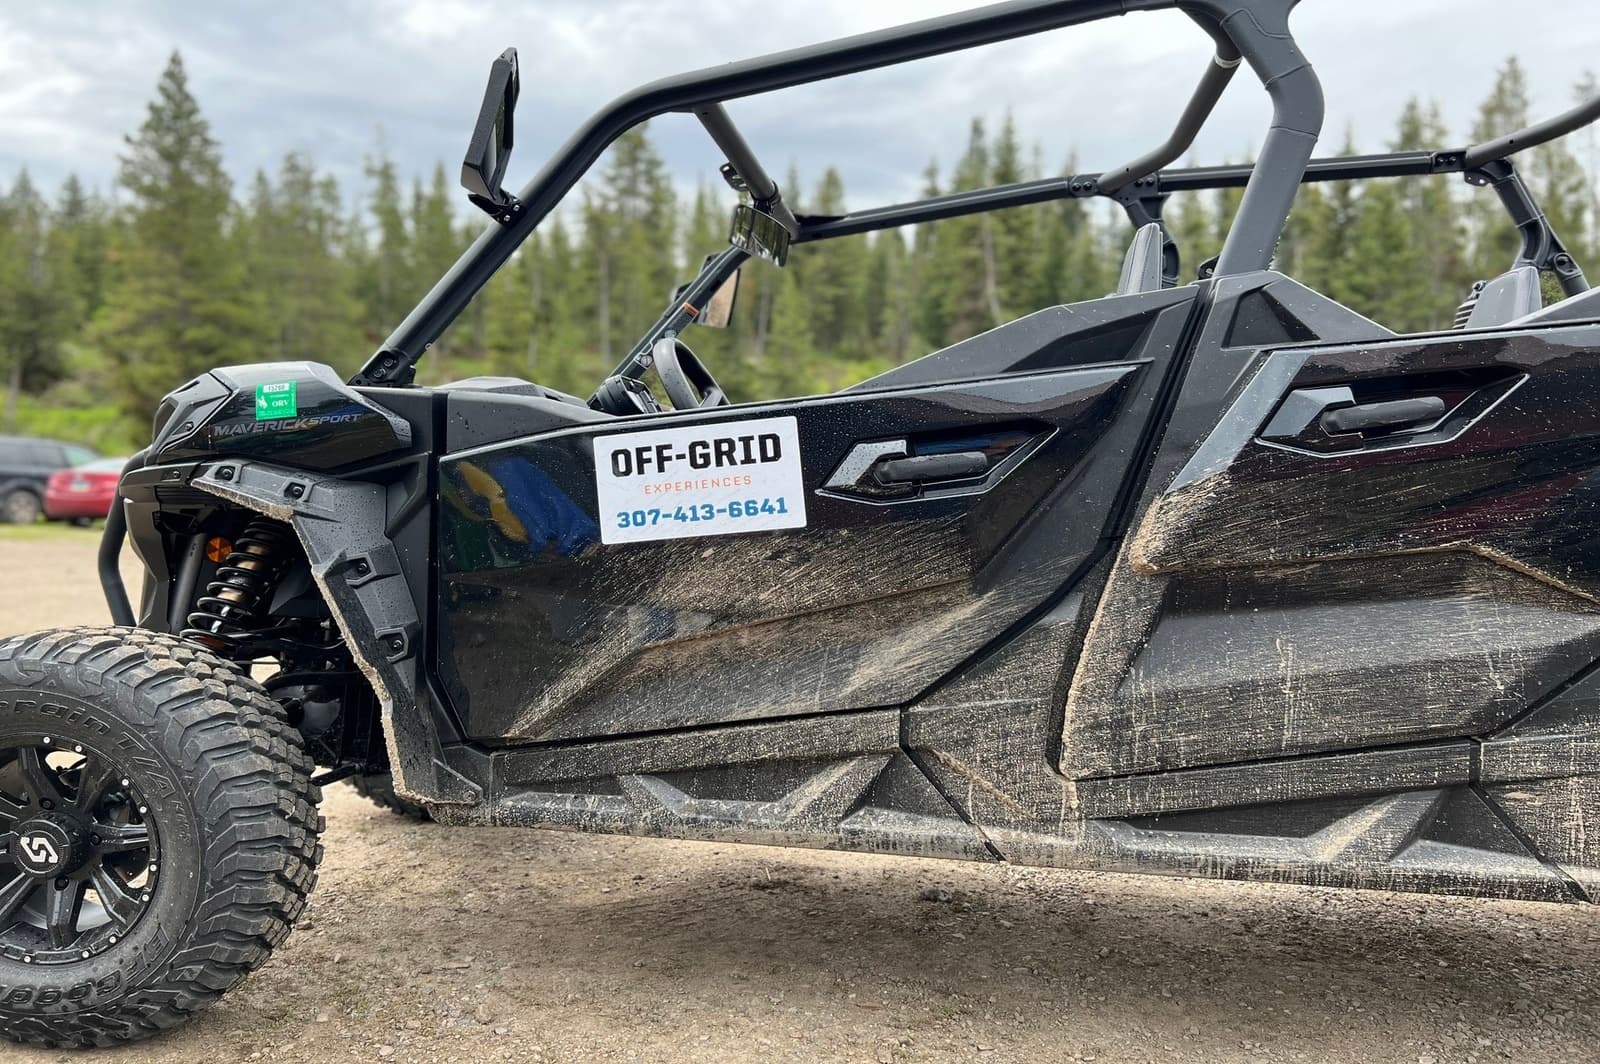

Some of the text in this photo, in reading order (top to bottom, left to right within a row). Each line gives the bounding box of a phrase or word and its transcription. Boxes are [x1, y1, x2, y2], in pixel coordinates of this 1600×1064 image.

[271, 399, 290, 408] ORV
[610, 432, 782, 477] OFF-GRID
[644, 475, 752, 495] EXPERIENCES
[616, 496, 788, 529] 307-413-6641
